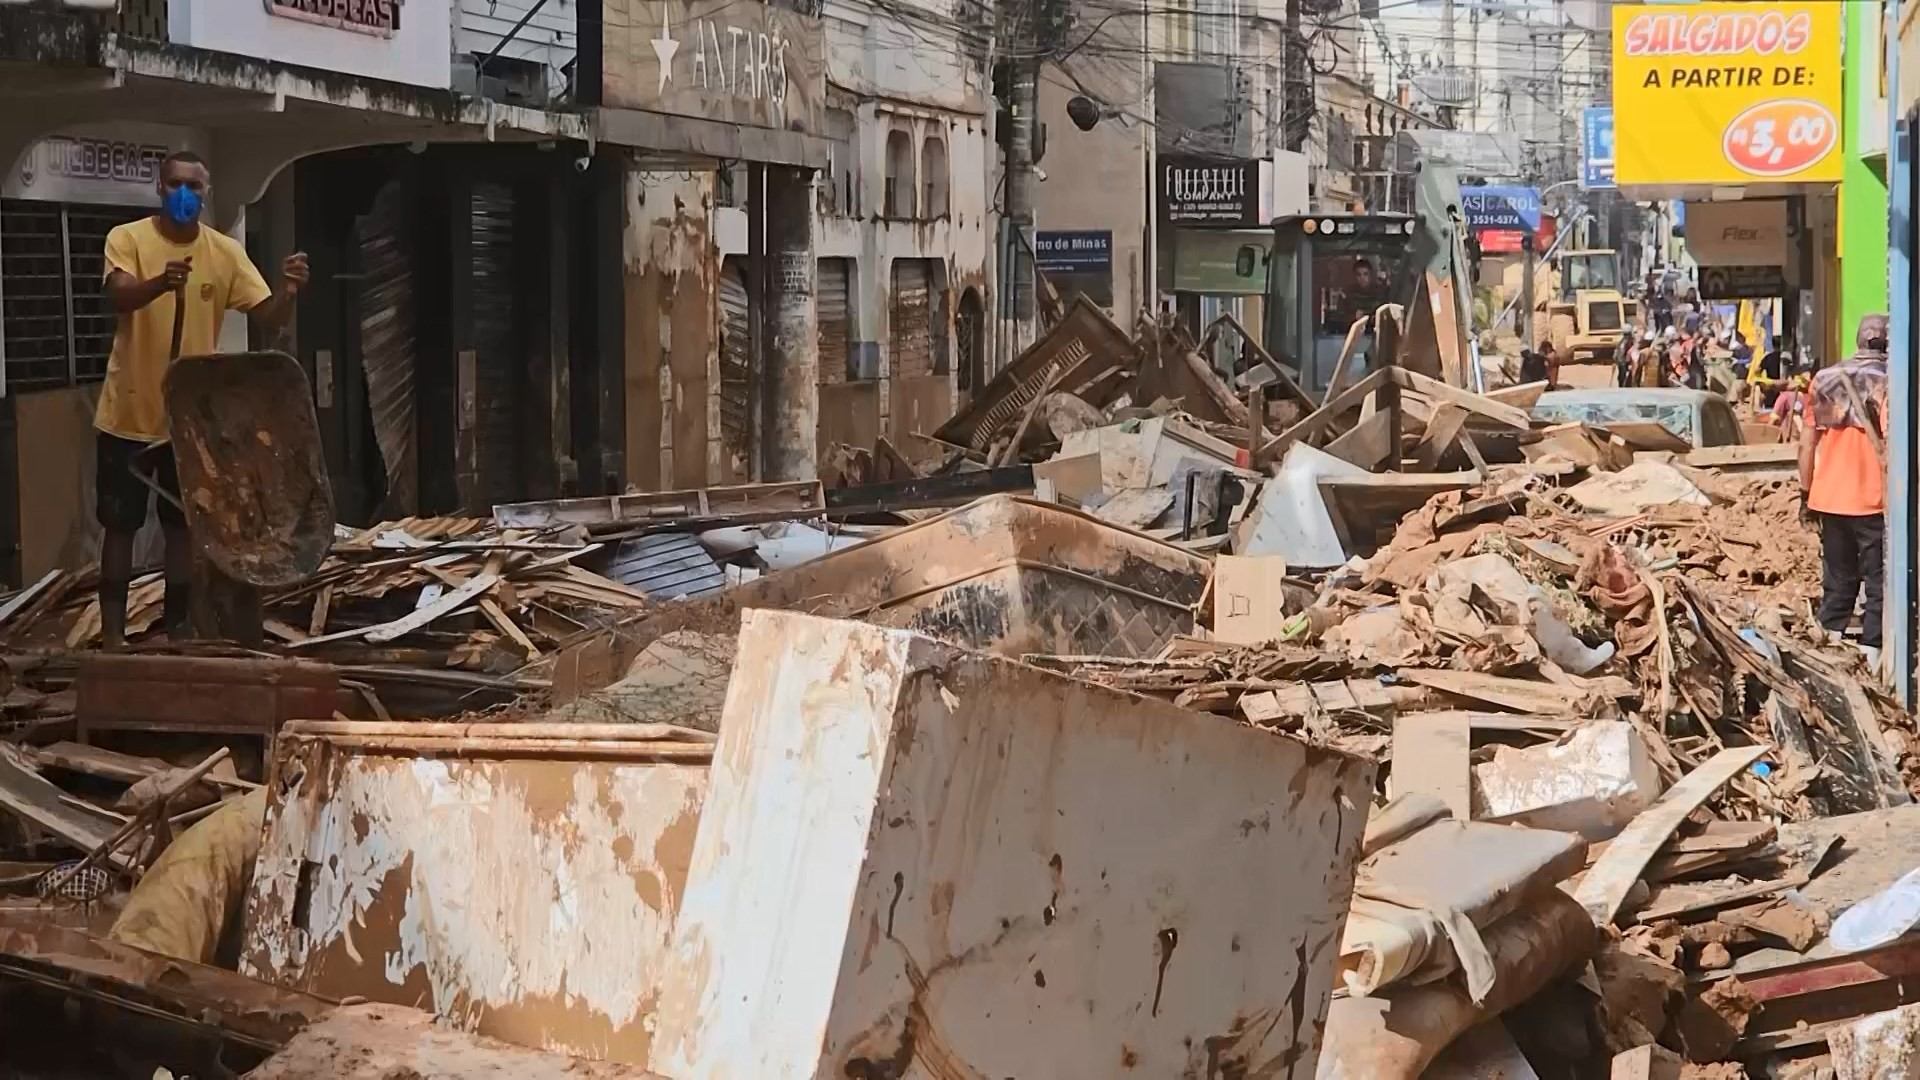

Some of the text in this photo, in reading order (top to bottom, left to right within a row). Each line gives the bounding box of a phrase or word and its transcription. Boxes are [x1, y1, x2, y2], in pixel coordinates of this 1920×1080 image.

[1625, 11, 1811, 56] SALGADOS
[1642, 66, 1815, 88] A PARTIR DE:
[1166, 165, 1245, 198] FREESTYLE
[1174, 191, 1234, 202] COMPANY
[1721, 226, 1759, 241] Flex
[1054, 237, 1069, 250] de
[1072, 238, 1107, 250] Minas
